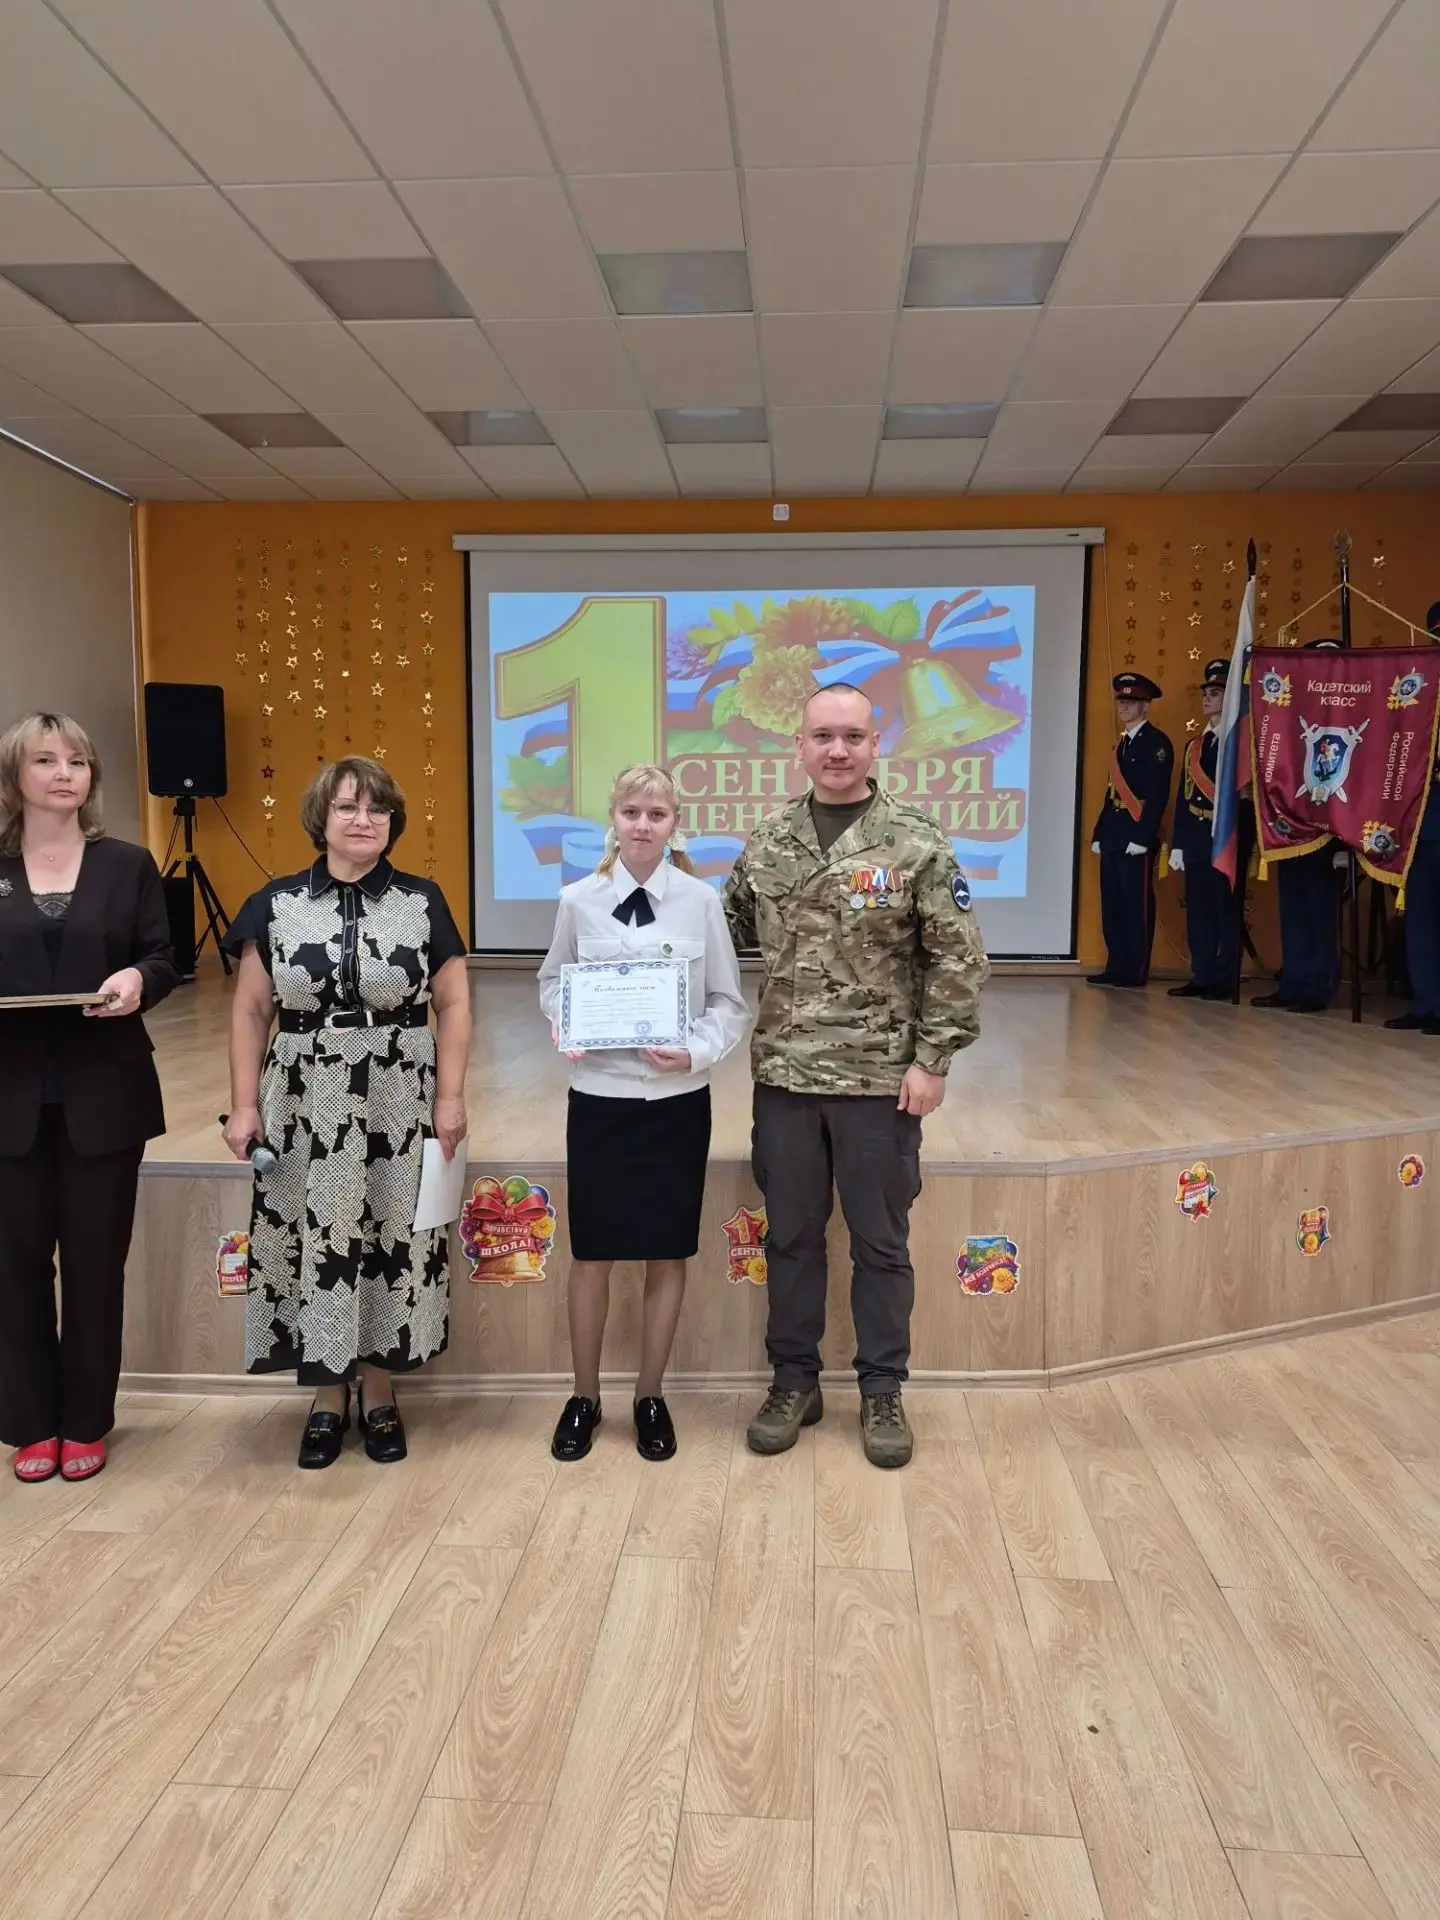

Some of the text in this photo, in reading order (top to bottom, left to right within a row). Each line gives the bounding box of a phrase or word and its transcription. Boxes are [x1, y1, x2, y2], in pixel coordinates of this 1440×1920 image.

[495, 597, 667, 824] 1
[671, 756, 986, 797] СЕНБРЯ
[1393, 731, 1415, 801] Российской
[481, 1238, 531, 1256] ШКОЛА!
